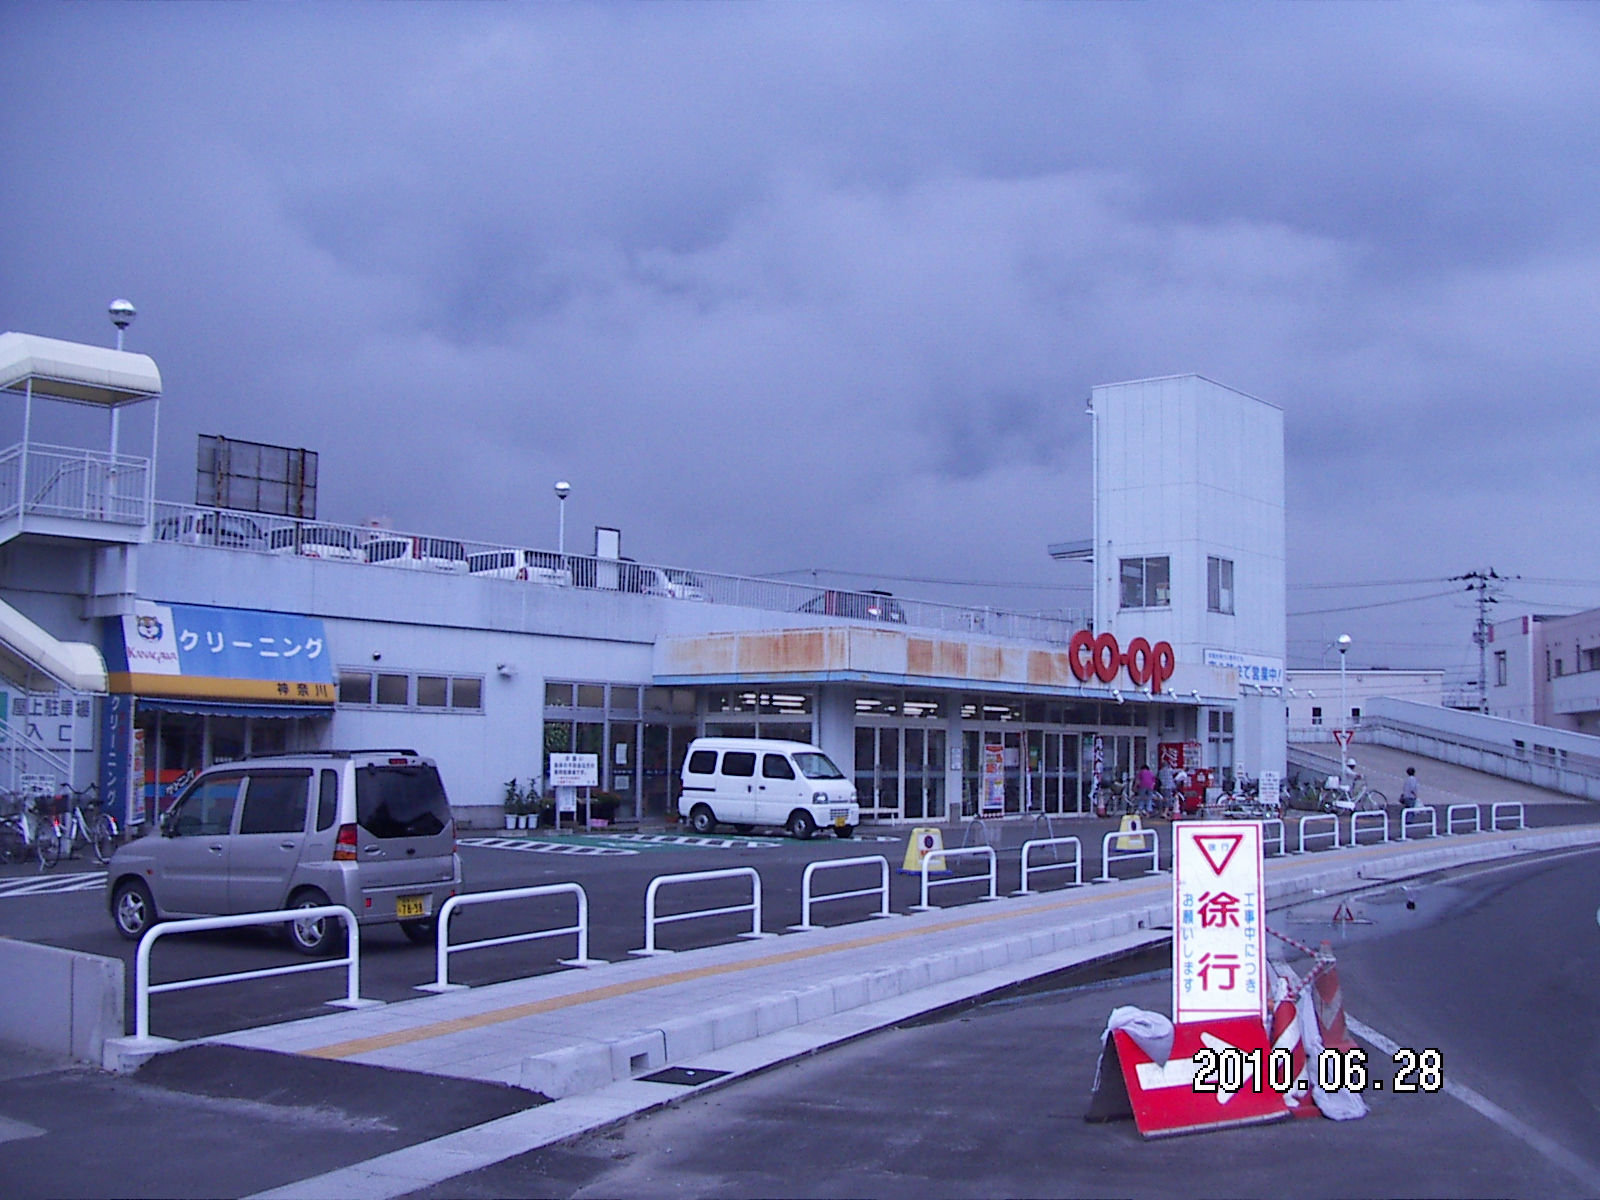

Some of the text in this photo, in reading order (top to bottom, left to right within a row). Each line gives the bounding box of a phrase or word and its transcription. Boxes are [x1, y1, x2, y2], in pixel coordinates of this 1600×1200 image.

[180, 629, 323, 659] クリーニング
[12, 698, 90, 718] 屋上駐車場
[277, 682, 328, 697] 神奈川
[27, 723, 72, 741] 入口
[107, 695, 120, 806] クリーニング
[1182, 892, 1194, 993] お願いします
[1197, 891, 1241, 991] 徐行
[1244, 892, 1256, 993] 工事中につき
